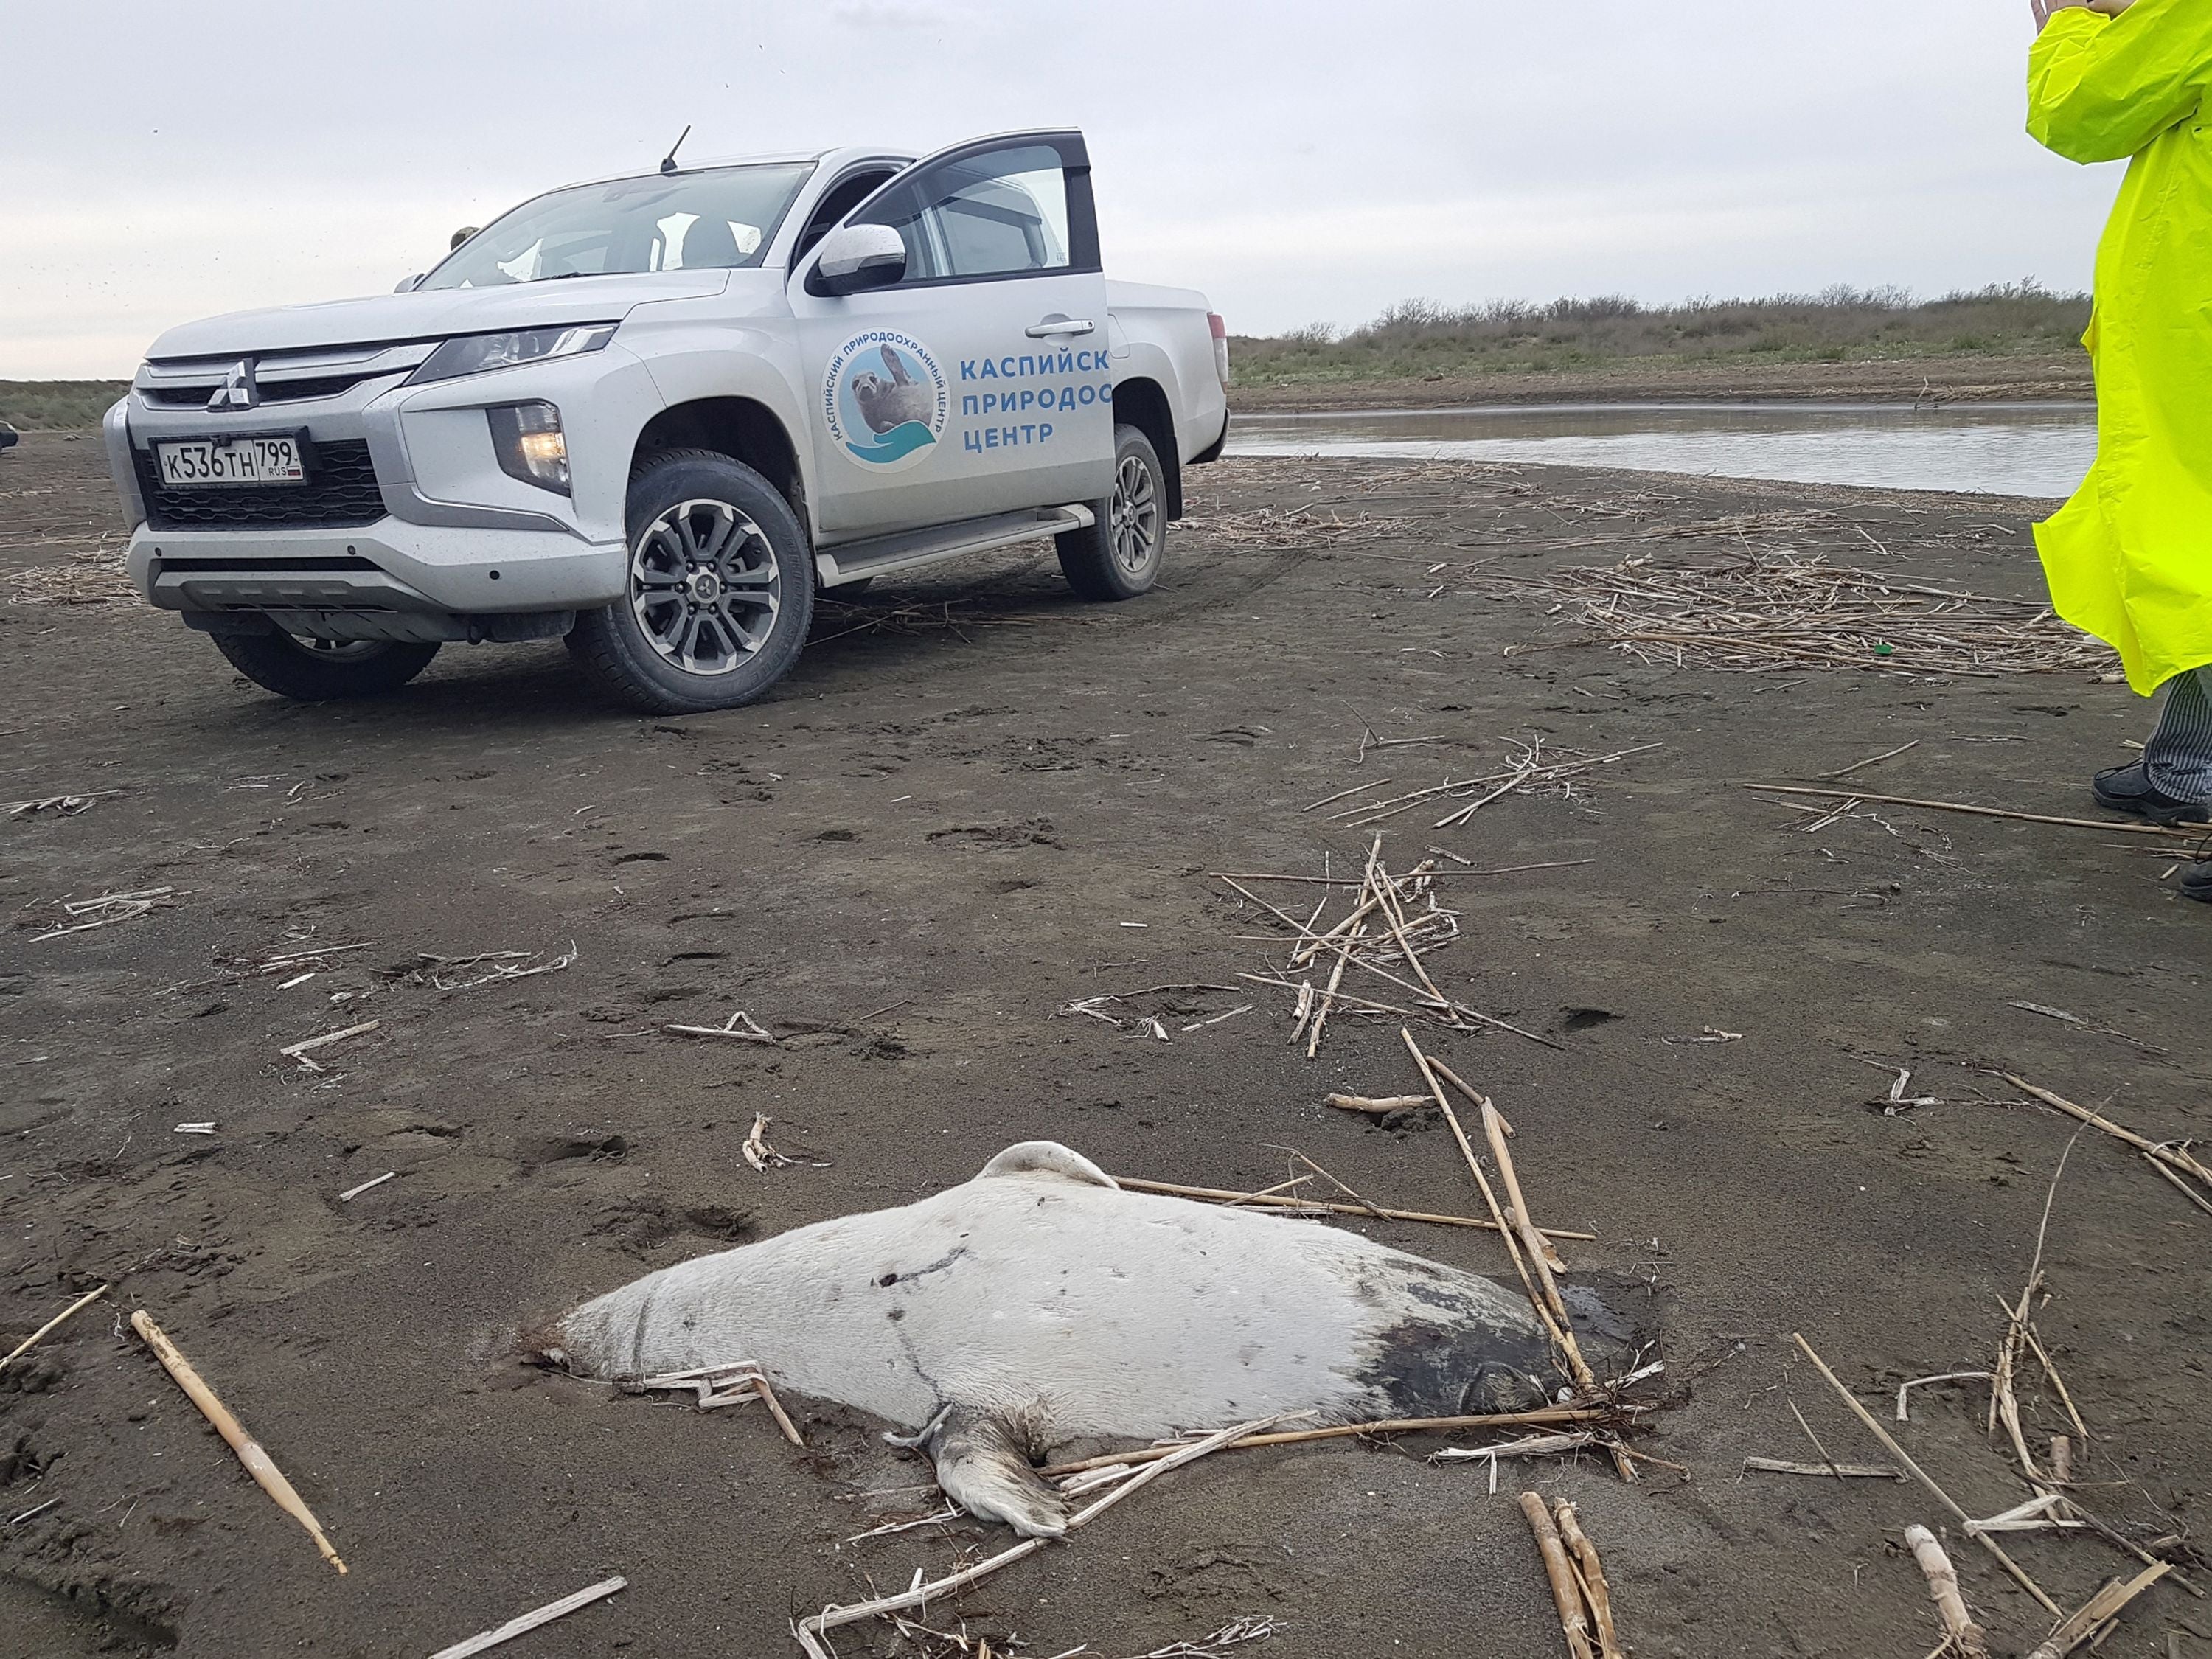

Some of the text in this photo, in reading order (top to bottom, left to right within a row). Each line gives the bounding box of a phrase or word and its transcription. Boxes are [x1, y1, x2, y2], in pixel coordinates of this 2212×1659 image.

[961, 347, 1110, 380] КАСПИЙСК
[823, 332, 946, 440] КАСПИЙСКИЙ ПРИРОДООХРАННЫЙ ЦЕНТР
[964, 422, 1054, 453] ЦЕНТР
[255, 442, 292, 467] 799
[268, 467, 287, 476] RUS
